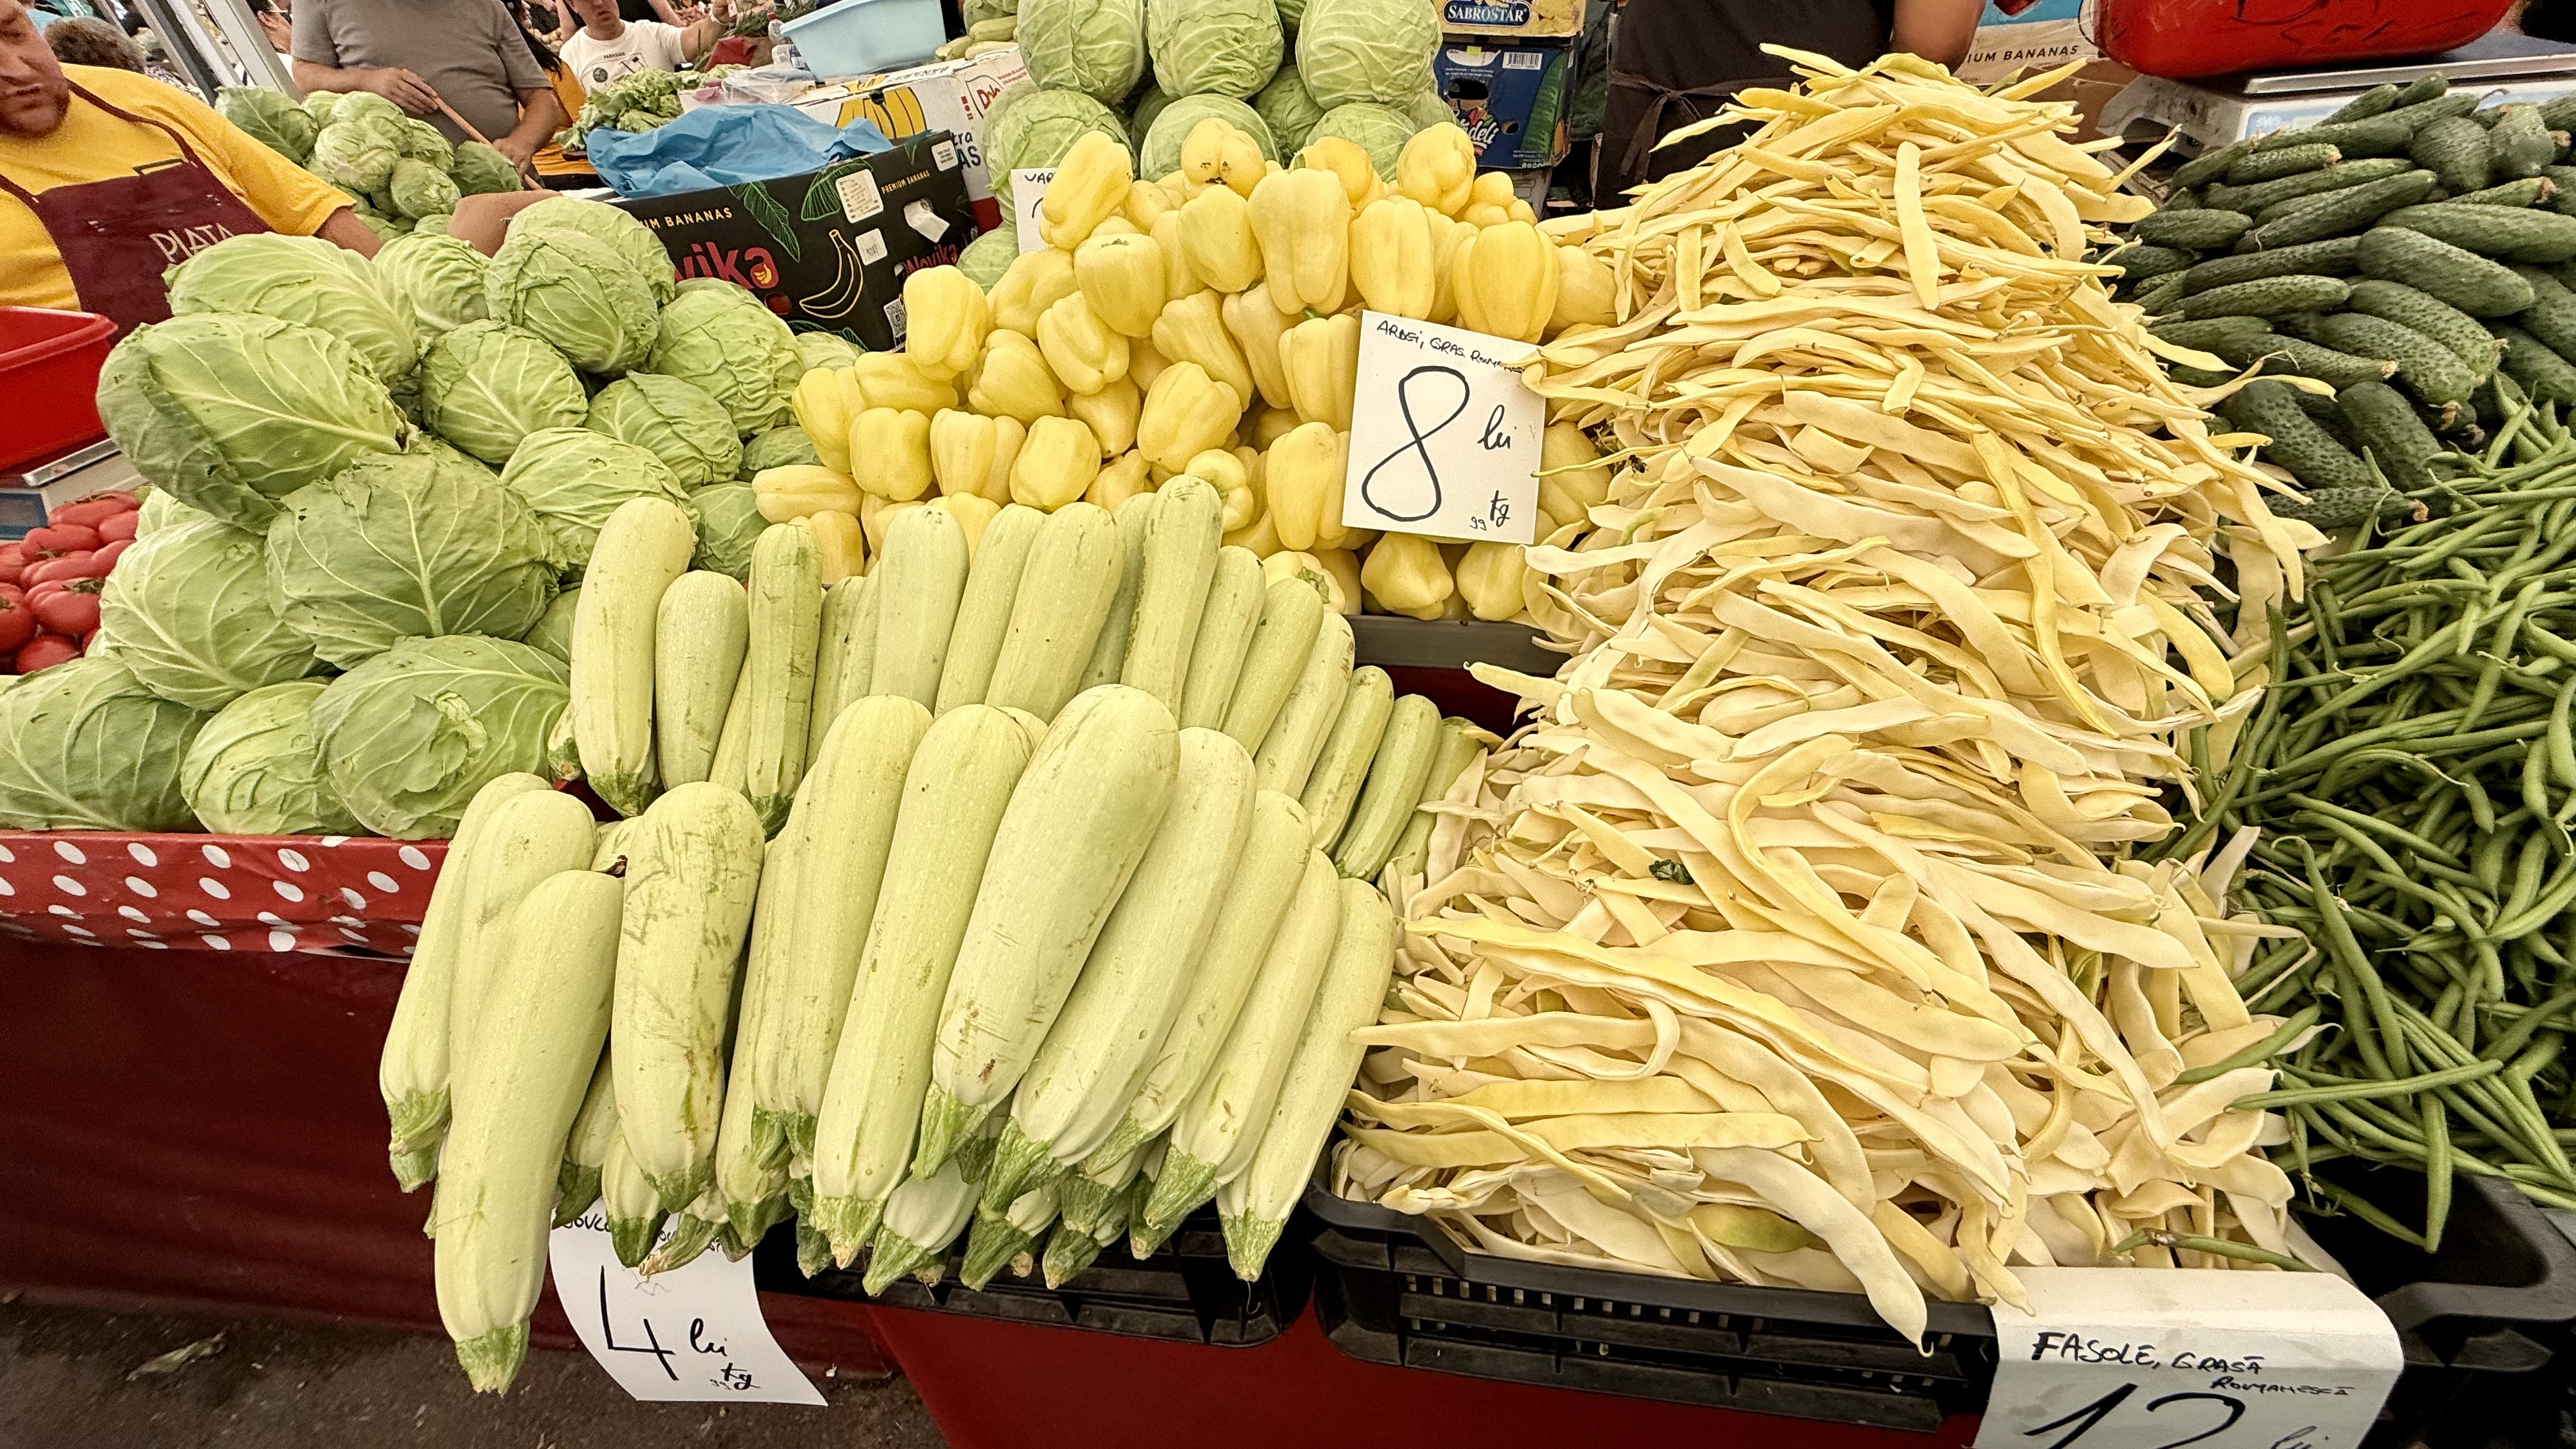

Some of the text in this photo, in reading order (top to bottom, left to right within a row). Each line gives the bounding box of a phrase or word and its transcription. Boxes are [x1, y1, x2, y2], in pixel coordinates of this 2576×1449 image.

[1448, 5, 1524, 22] SABROSTAR
[2003, 45, 2079, 61] BANANAS
[882, 169, 930, 195] PREMIUM BANANAS
[664, 207, 732, 227] BANANAS
[1361, 365, 1469, 522] 8
[601, 1265, 679, 1381] 4
